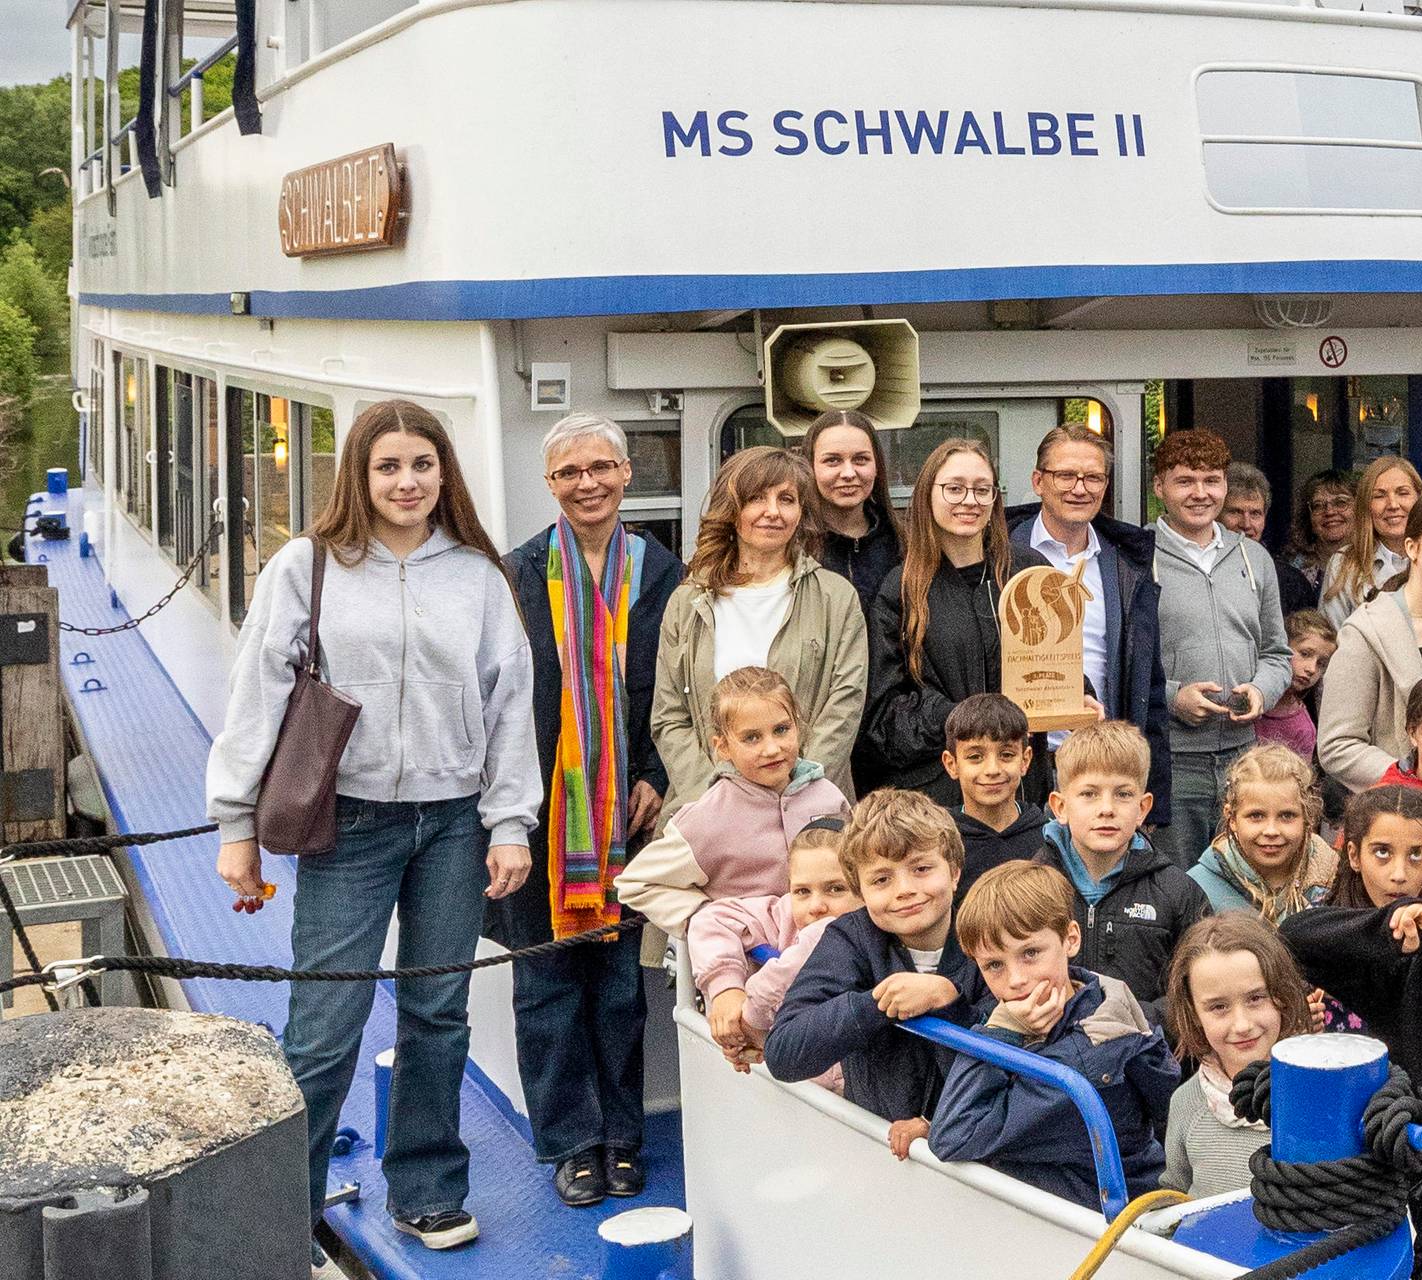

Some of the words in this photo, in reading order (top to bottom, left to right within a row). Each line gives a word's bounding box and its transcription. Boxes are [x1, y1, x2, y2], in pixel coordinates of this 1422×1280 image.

[661, 109, 754, 158] MS
[772, 109, 1099, 157] SCHWALBE
[1114, 113, 1147, 158] II
[283, 158, 364, 251] SCHWALBE
